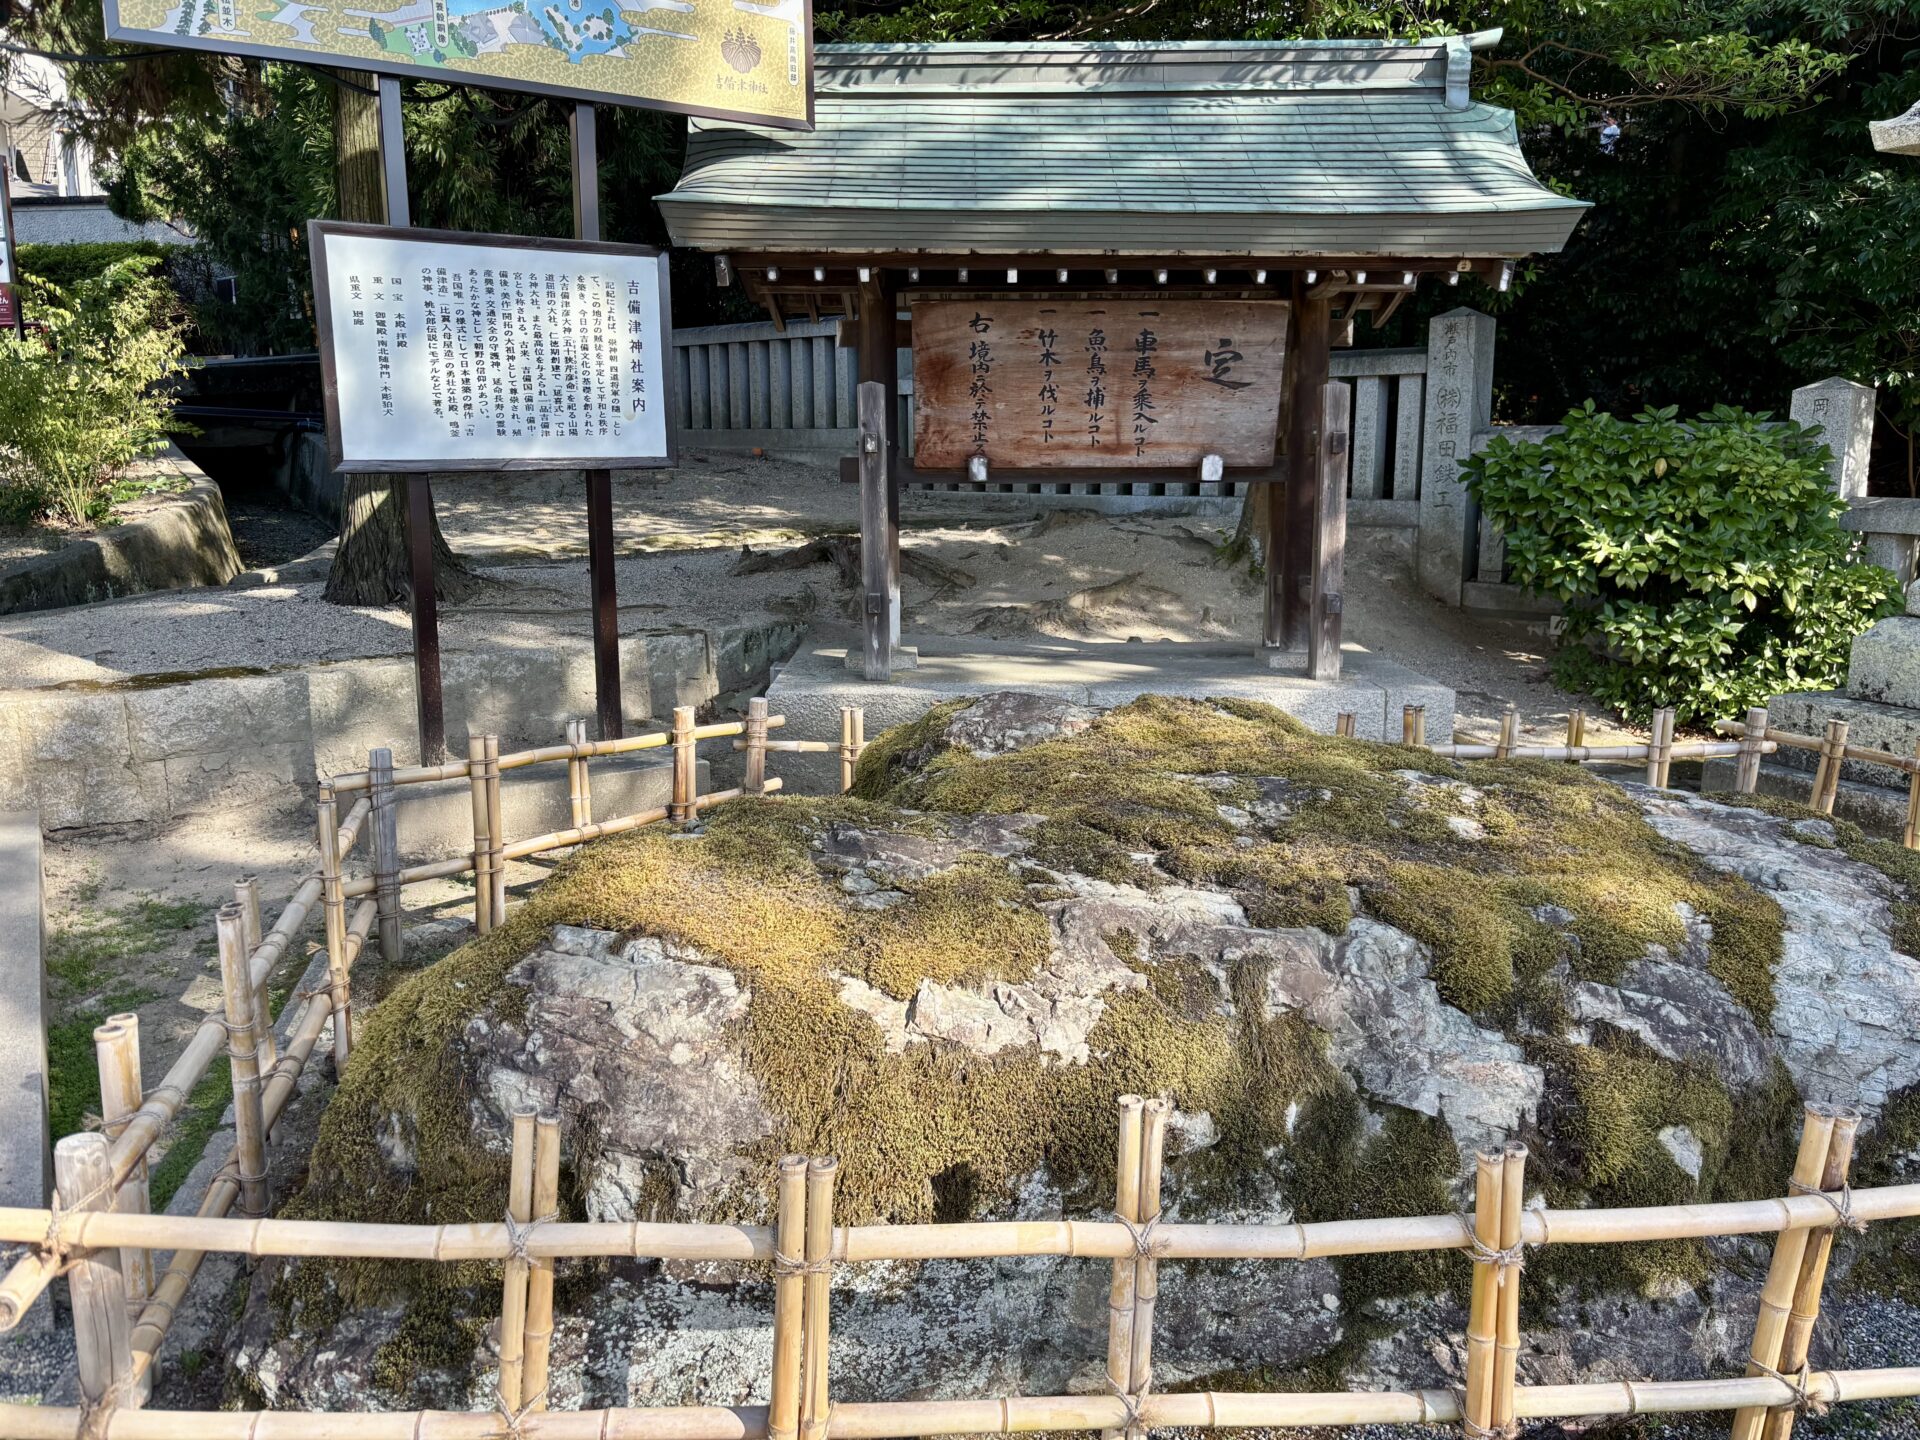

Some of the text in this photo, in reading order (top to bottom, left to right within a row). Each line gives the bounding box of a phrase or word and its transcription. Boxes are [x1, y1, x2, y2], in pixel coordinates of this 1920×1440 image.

[626, 280, 646, 413] 吉備津神社案内
